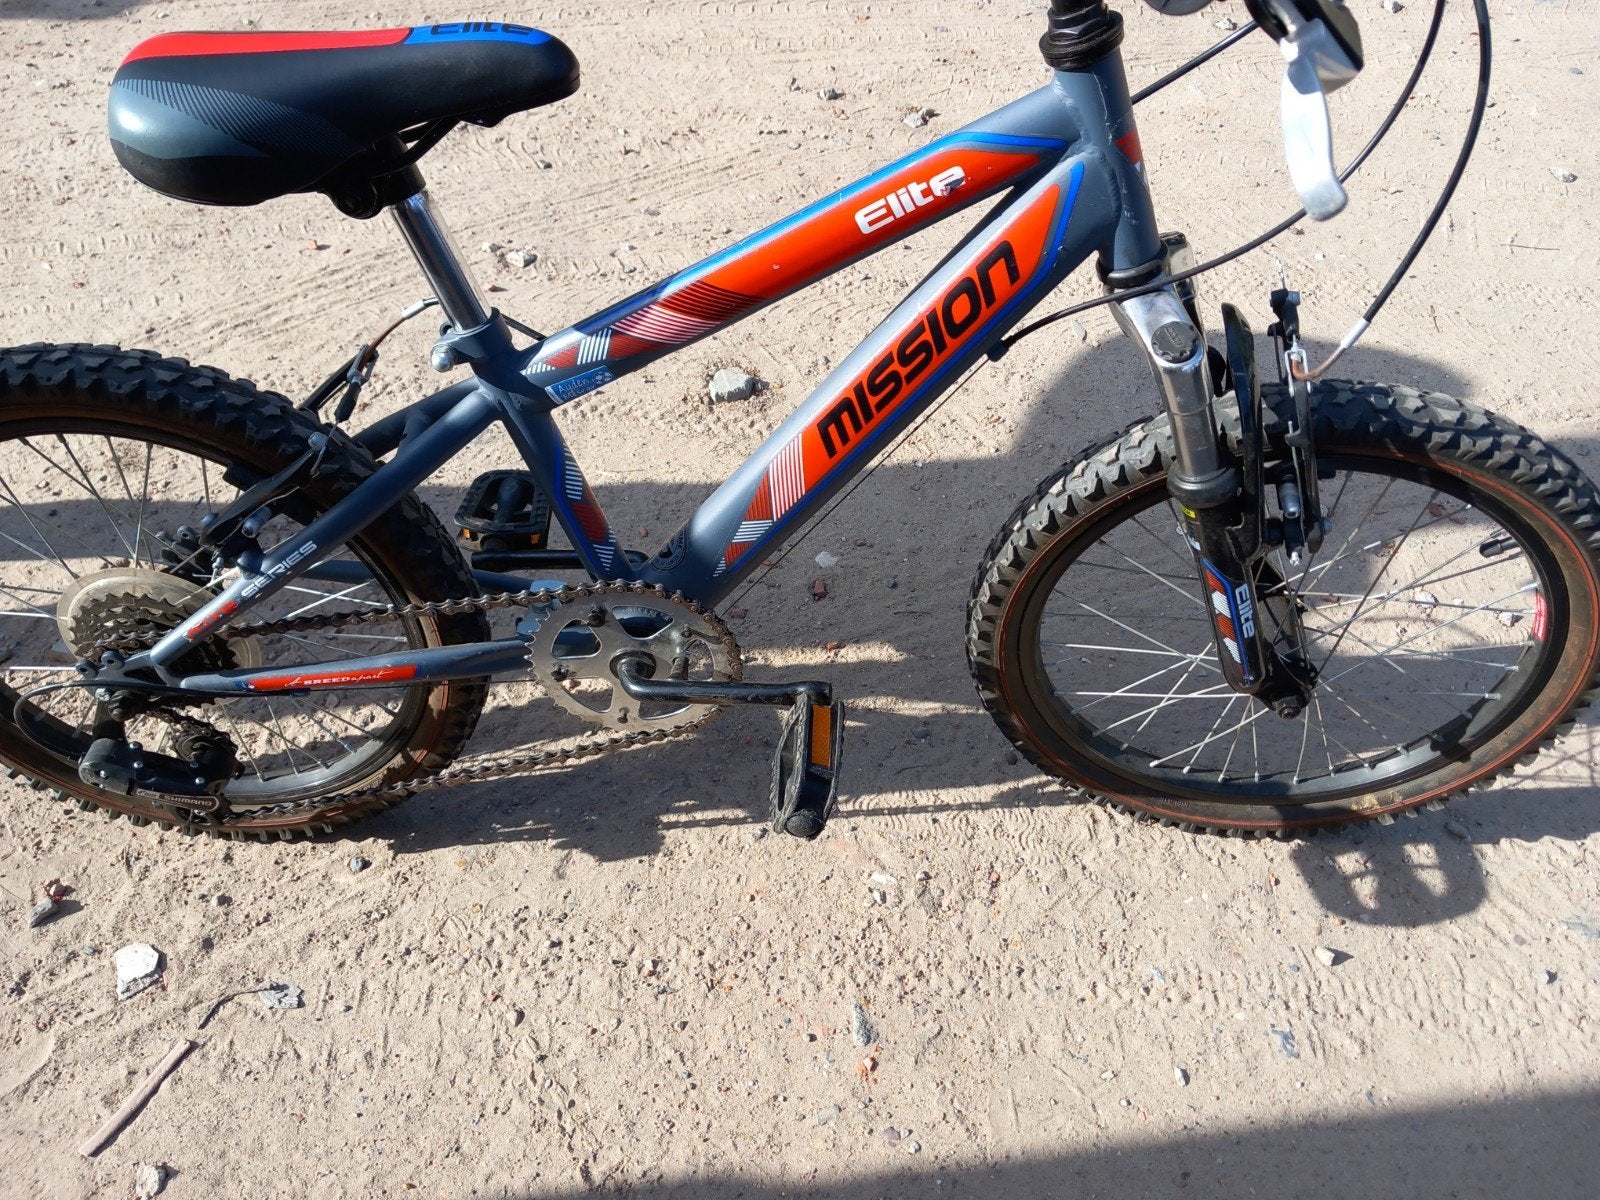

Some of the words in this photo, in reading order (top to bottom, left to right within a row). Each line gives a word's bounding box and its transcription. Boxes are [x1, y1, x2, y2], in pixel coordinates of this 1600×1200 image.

[854, 165, 966, 235] Elite
[241, 540, 318, 598] SERIES
[1234, 582, 1255, 639] Elite
[303, 676, 350, 686] BREED
[163, 795, 213, 807] SHIMANO
